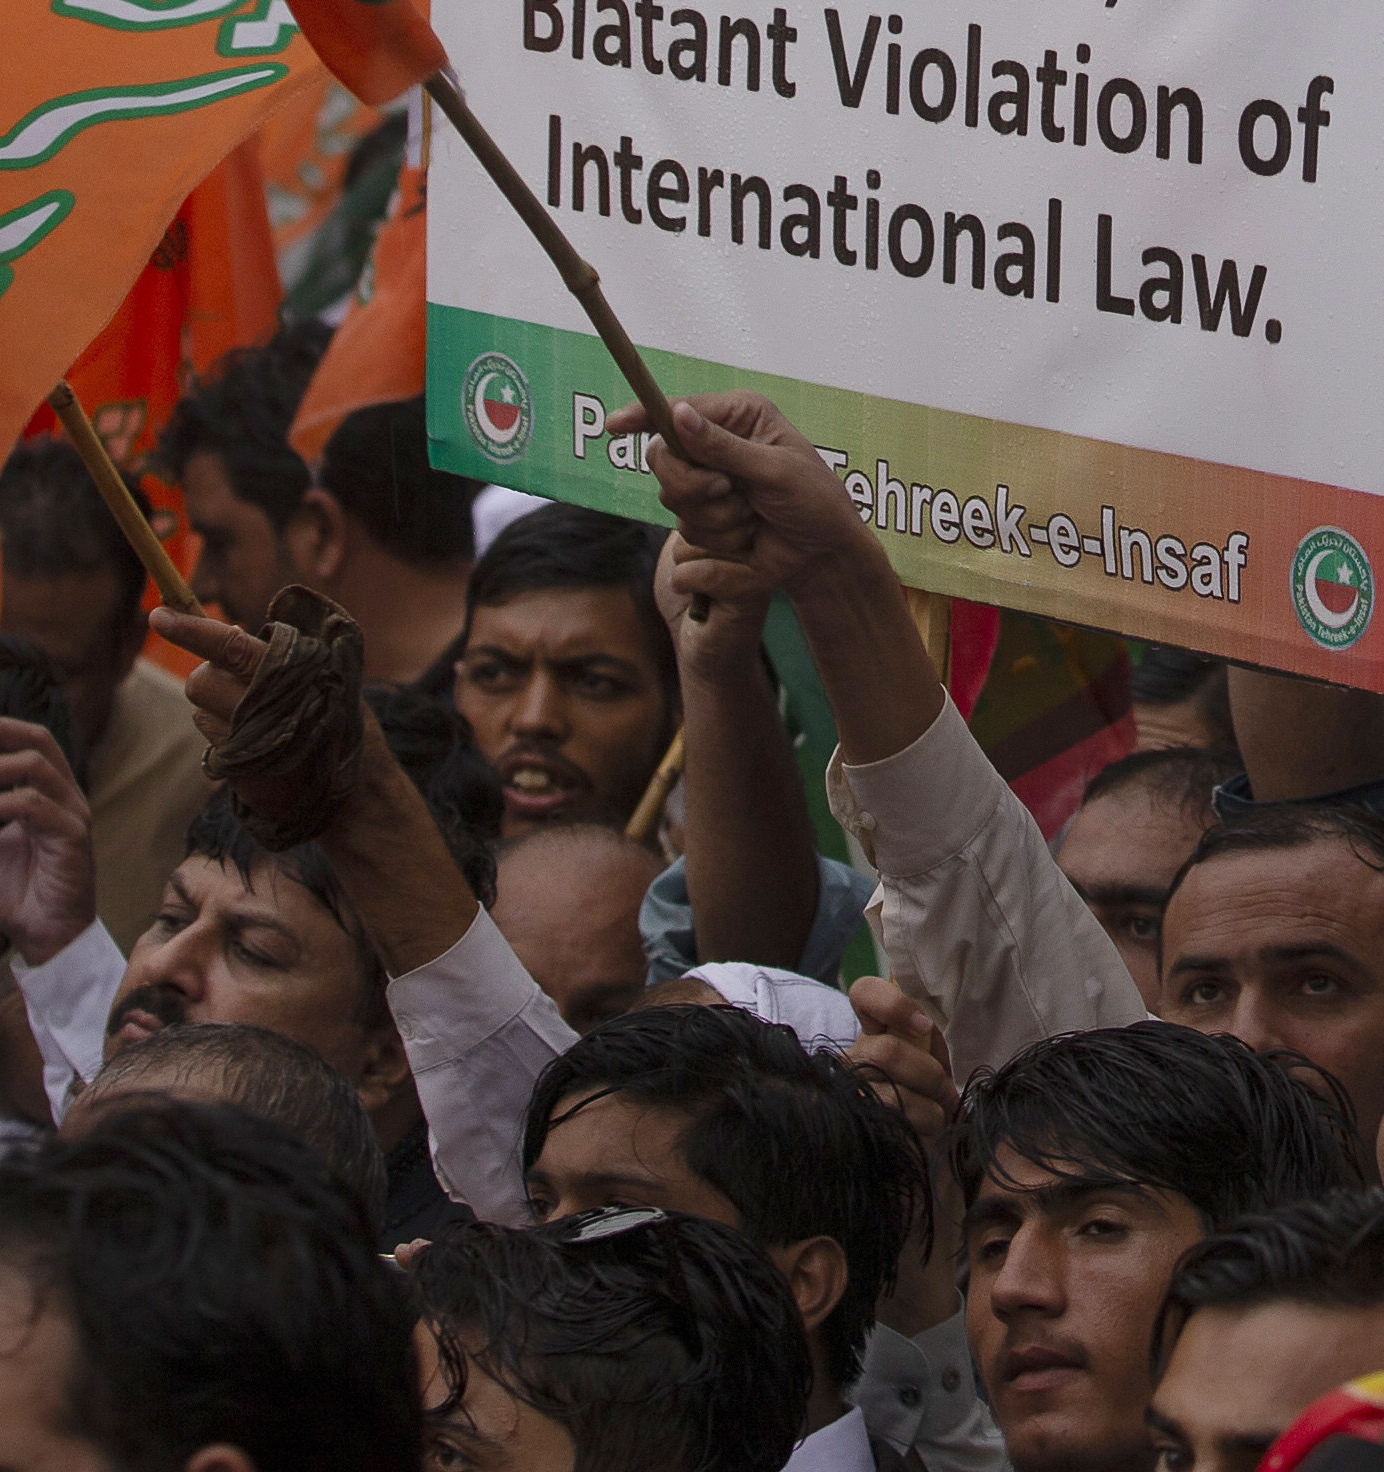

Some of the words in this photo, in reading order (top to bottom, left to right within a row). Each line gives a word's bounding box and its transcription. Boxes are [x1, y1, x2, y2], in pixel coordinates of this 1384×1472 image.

[823, 7, 1204, 165] Violation
[1237, 75, 1335, 184] of
[547, 114, 1062, 304] International
[1095, 213, 1282, 345] Law.
